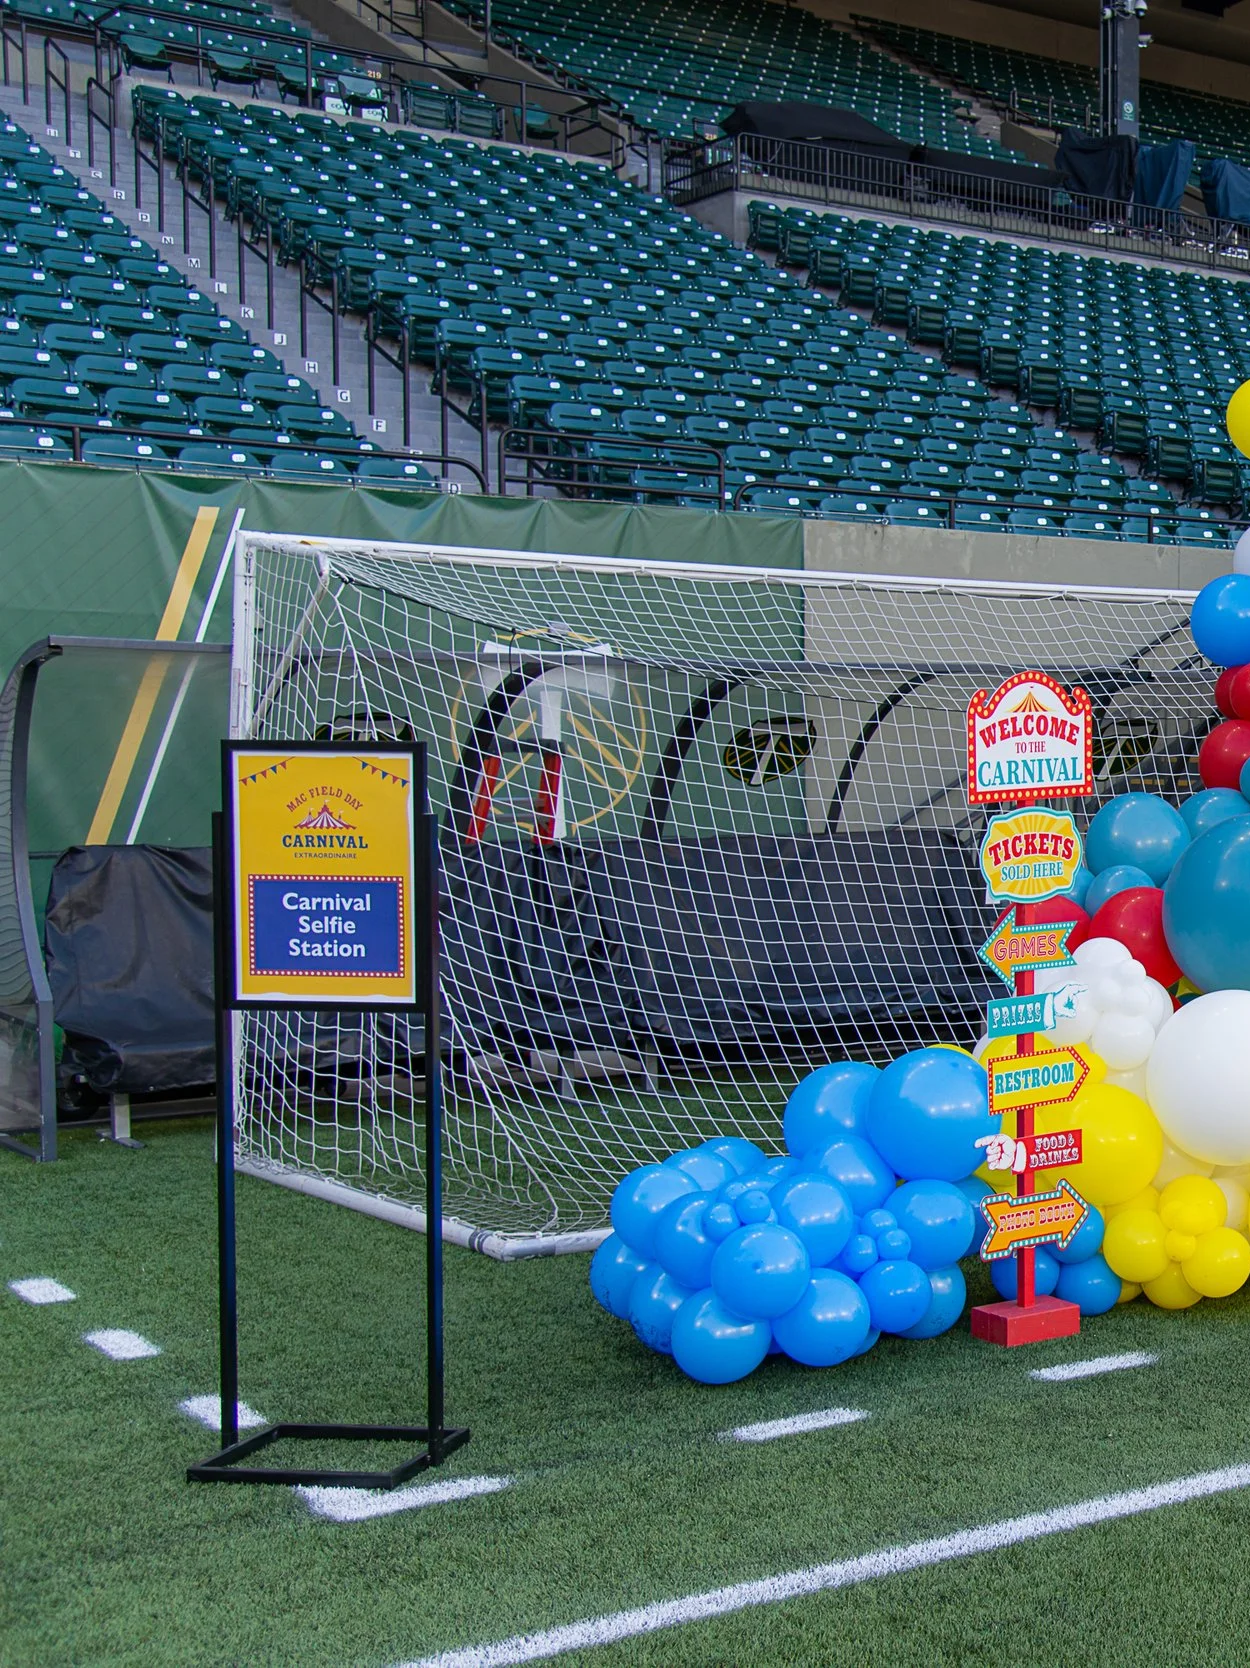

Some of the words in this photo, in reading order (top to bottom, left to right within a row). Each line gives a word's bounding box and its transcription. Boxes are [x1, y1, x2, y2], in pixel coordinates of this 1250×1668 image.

[367, 70, 382, 79] 219
[189, 259, 200, 268] M
[306, 362, 318, 373] H
[339, 391, 350, 401] G
[979, 714, 1080, 748] WELCOME
[1015, 742, 1027, 754] TO
[1028, 741, 1046, 753] THE
[978, 757, 1083, 787] CARNIVAL
[286, 793, 308, 812] MAC
[309, 786, 343, 800] FIELD
[344, 794, 363, 810] DAY
[282, 834, 368, 849] CARNIVAL
[988, 833, 1074, 867] TICKETS
[294, 852, 357, 860] EXTRAORDINAIRE
[1001, 864, 1030, 882] SOLD
[1033, 861, 1064, 879] HERE
[282, 892, 371, 911] Carnival
[299, 916, 356, 934] Selfie
[289, 938, 366, 957] Station
[993, 933, 1057, 961] GAMES
[992, 1002, 1042, 1029] PRIZES
[994, 1062, 1075, 1095] RESTROOM
[1035, 1134, 1066, 1152] FOOD
[1030, 1147, 1079, 1168] DRINKS
[999, 1210, 1036, 1232] PHOTO
[1039, 1203, 1076, 1224] BOOTH
